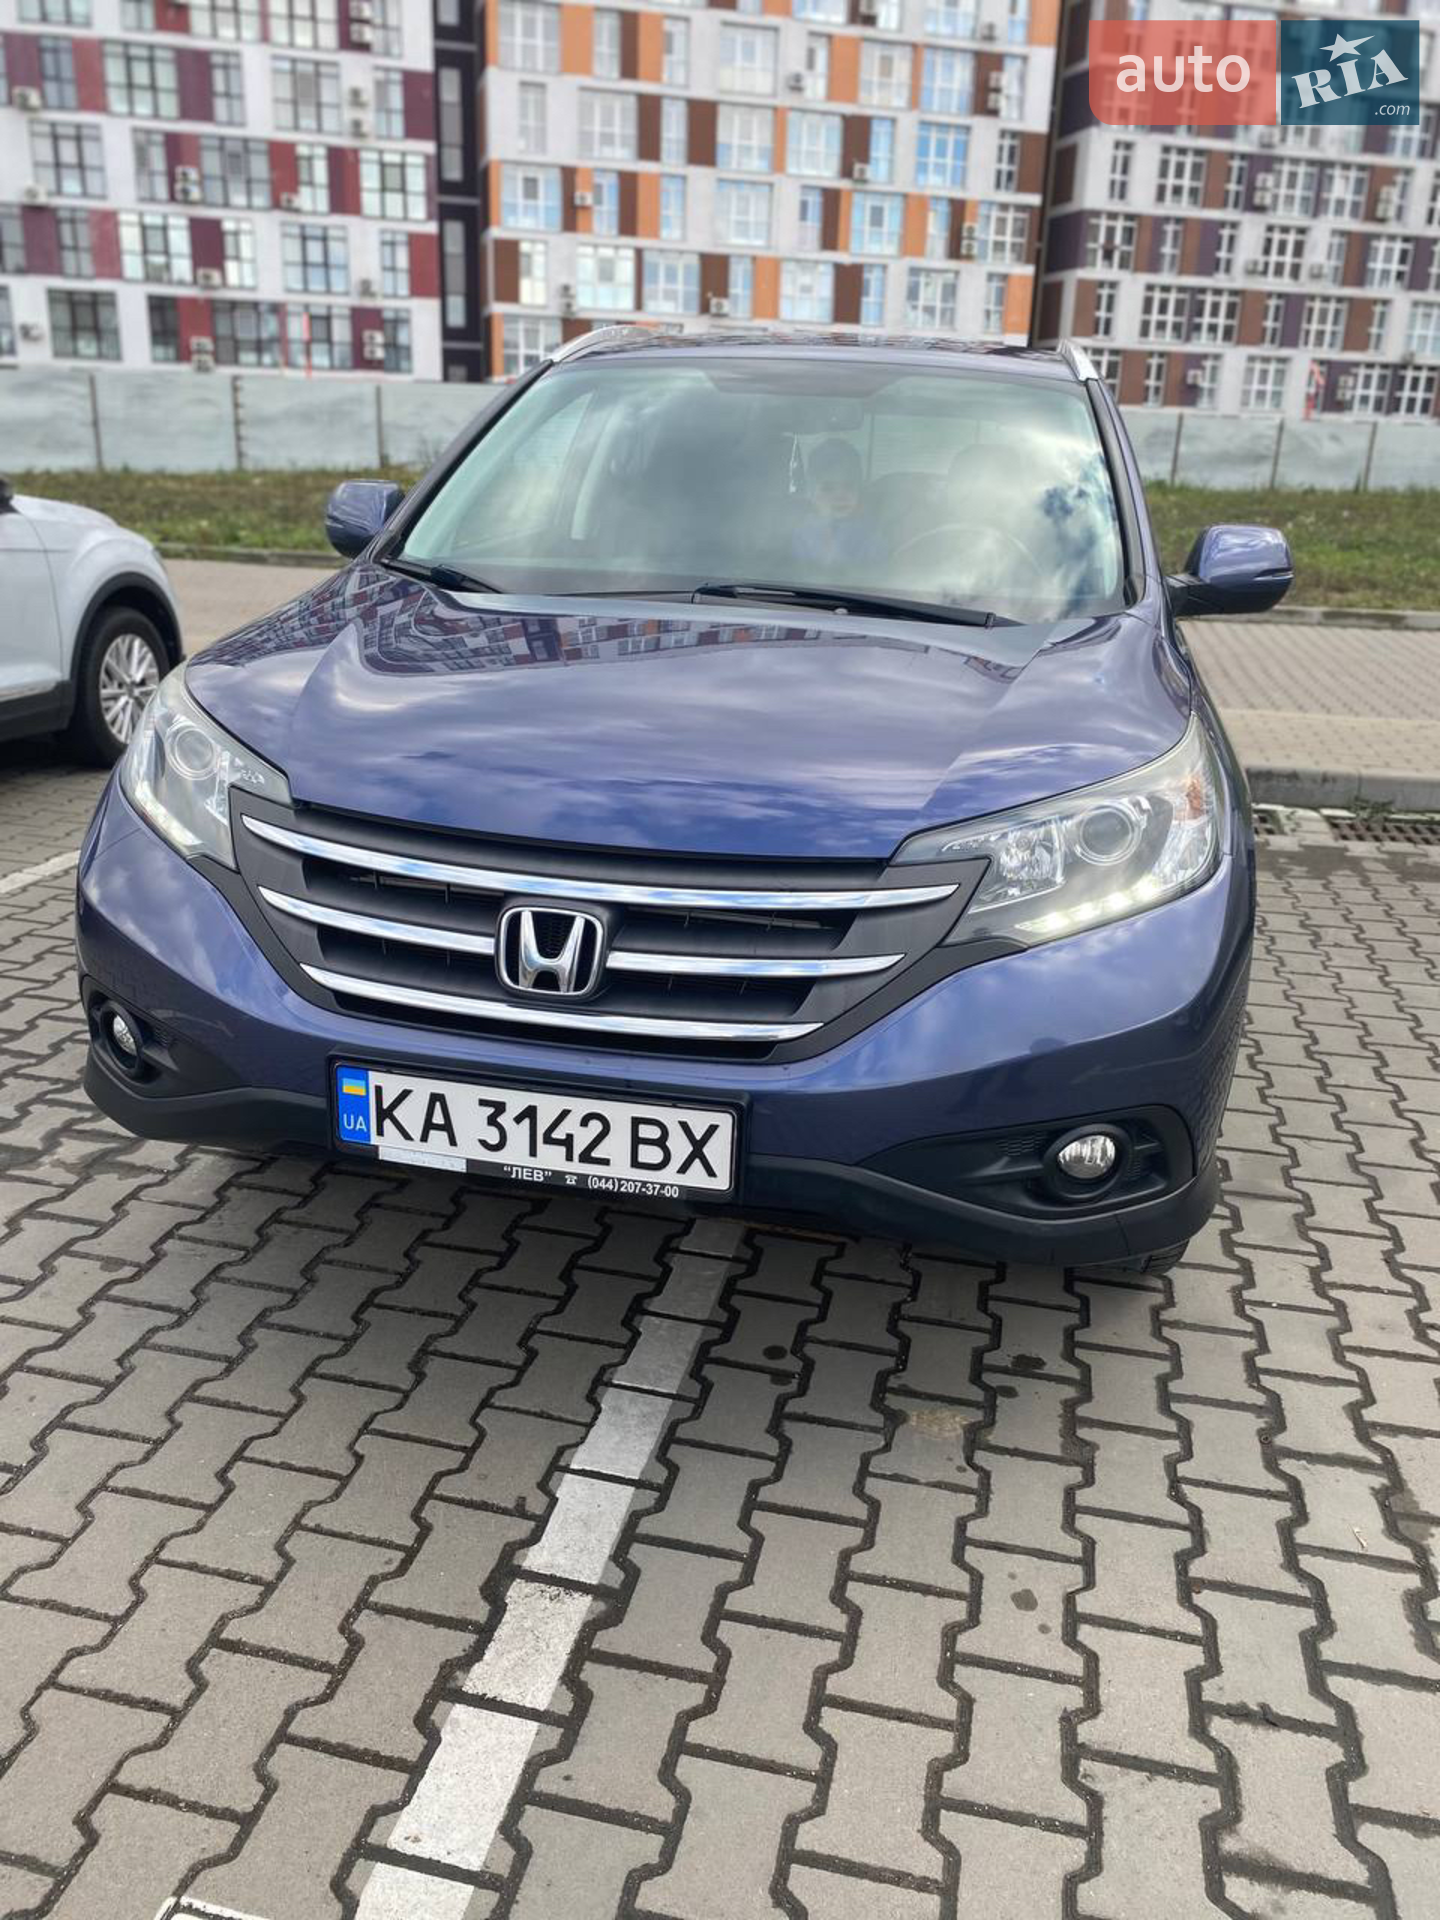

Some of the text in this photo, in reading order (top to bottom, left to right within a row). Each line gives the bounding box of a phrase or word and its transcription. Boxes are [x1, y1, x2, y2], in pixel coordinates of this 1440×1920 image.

[343, 1113, 367, 1132] UA
[374, 1084, 720, 1178] KA 3142 BX
